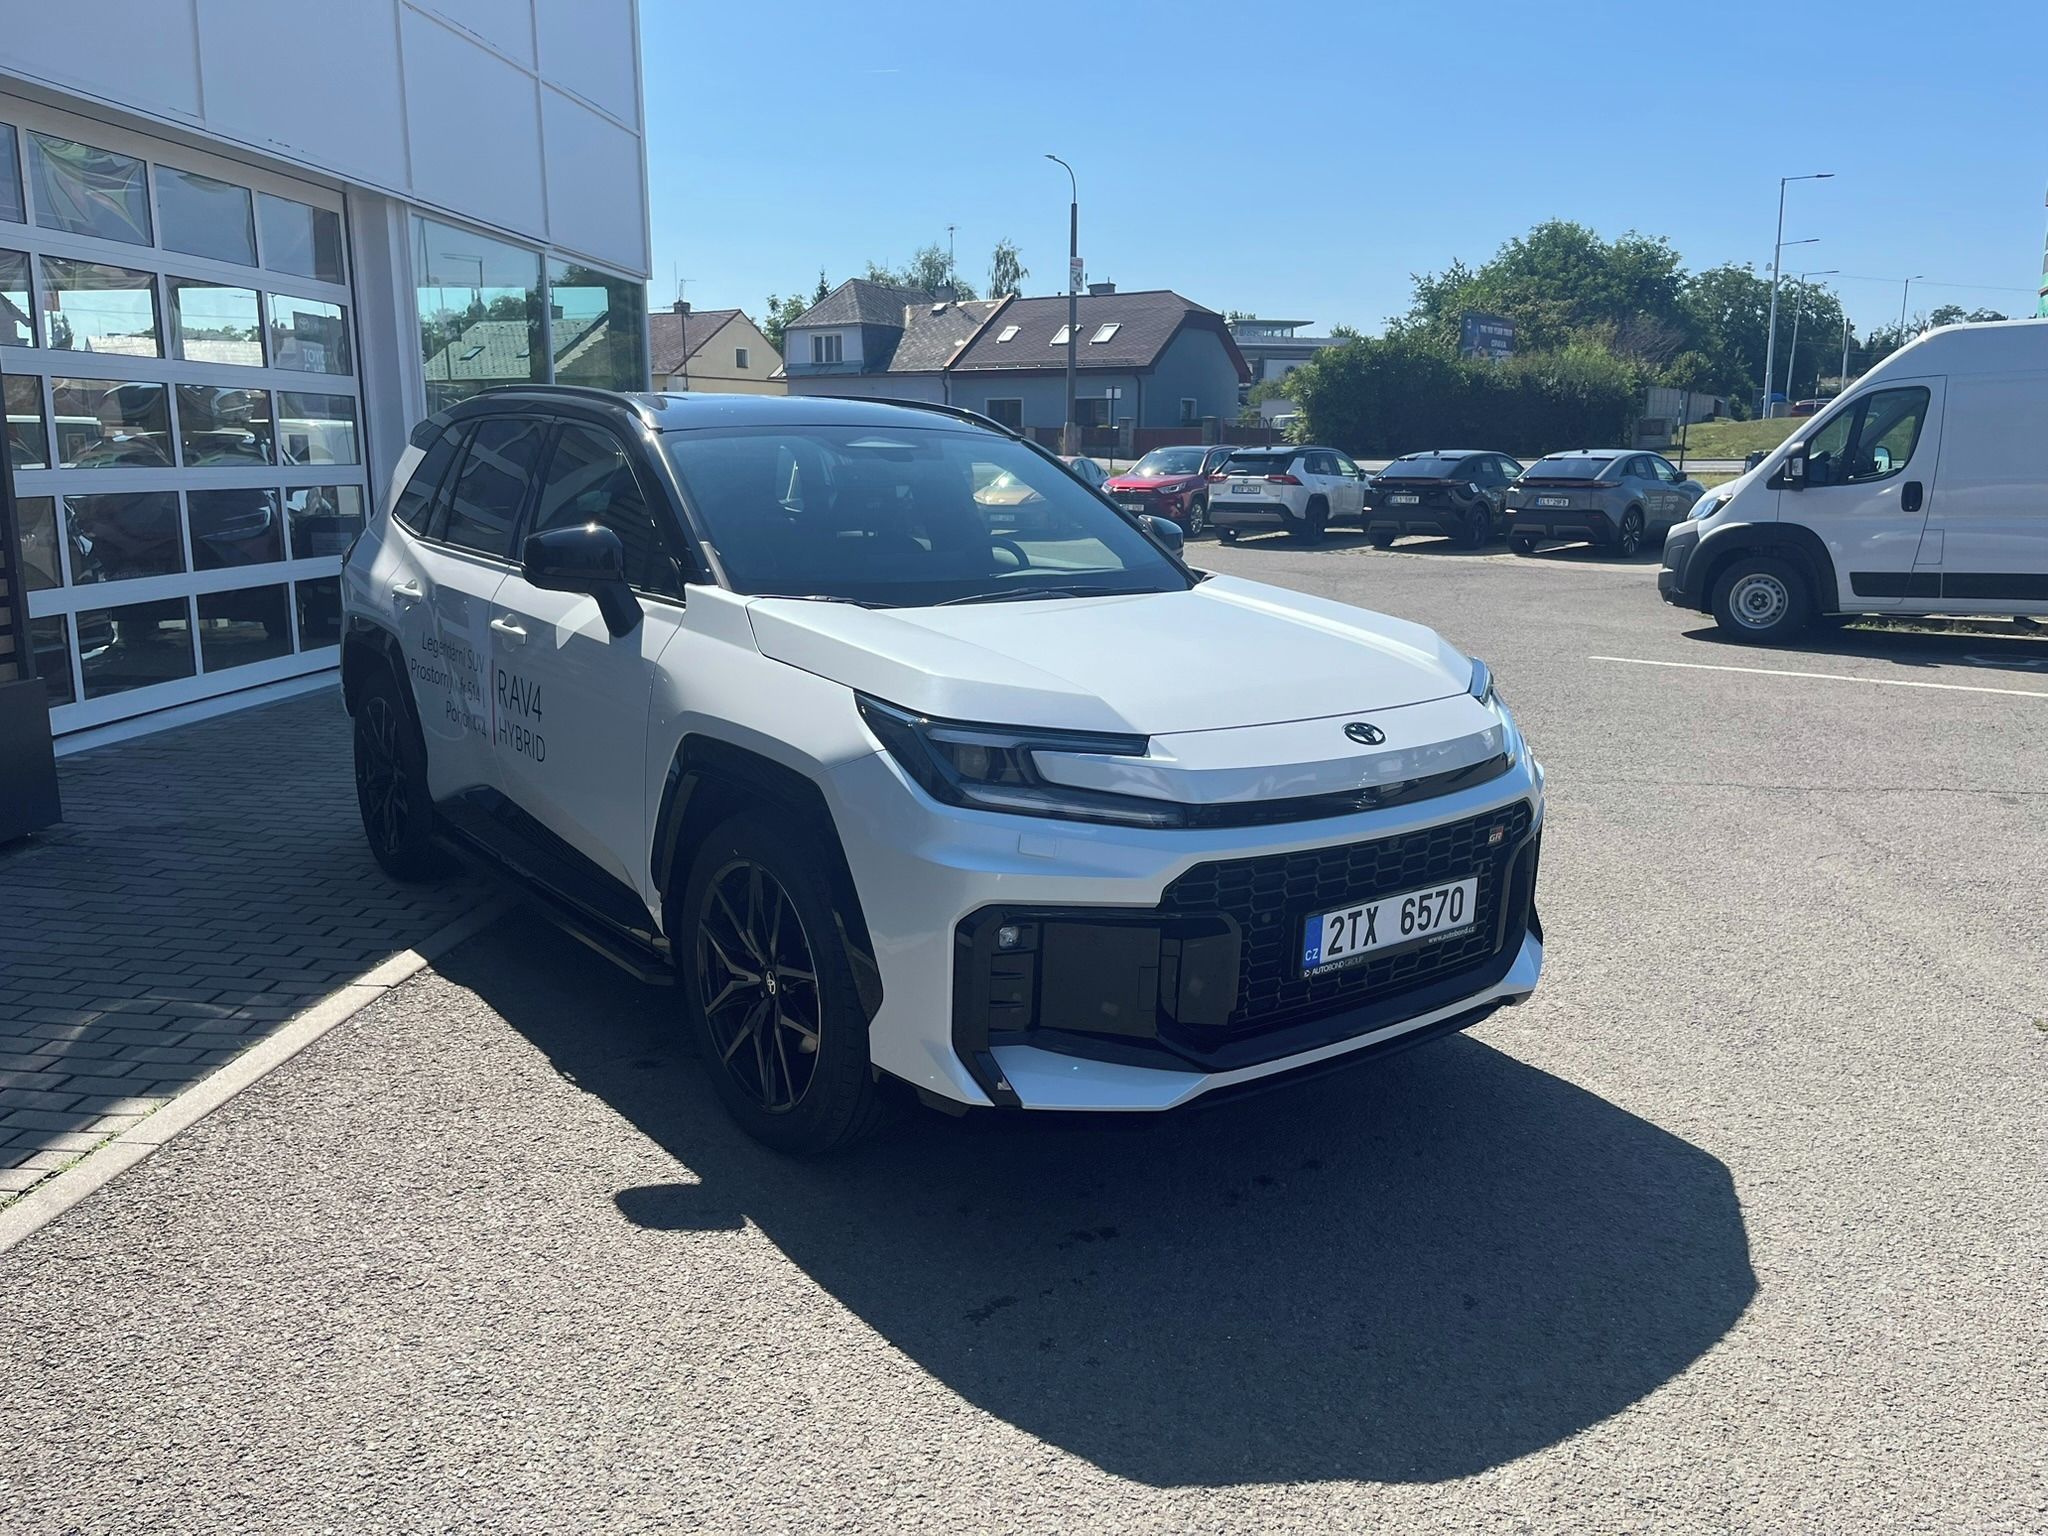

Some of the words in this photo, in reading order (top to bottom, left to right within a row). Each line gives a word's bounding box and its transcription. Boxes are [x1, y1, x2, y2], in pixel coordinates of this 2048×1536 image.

[467, 648, 485, 673] SUV
[498, 669, 543, 723] RAV4
[499, 717, 546, 763] HYBRID
[1327, 905, 1379, 956] 2TX
[1400, 886, 1465, 936] 6570
[1428, 926, 1475, 943] www.autobond.cz
[1305, 948, 1319, 961] CZ
[1311, 960, 1345, 975] AUTOBOND
